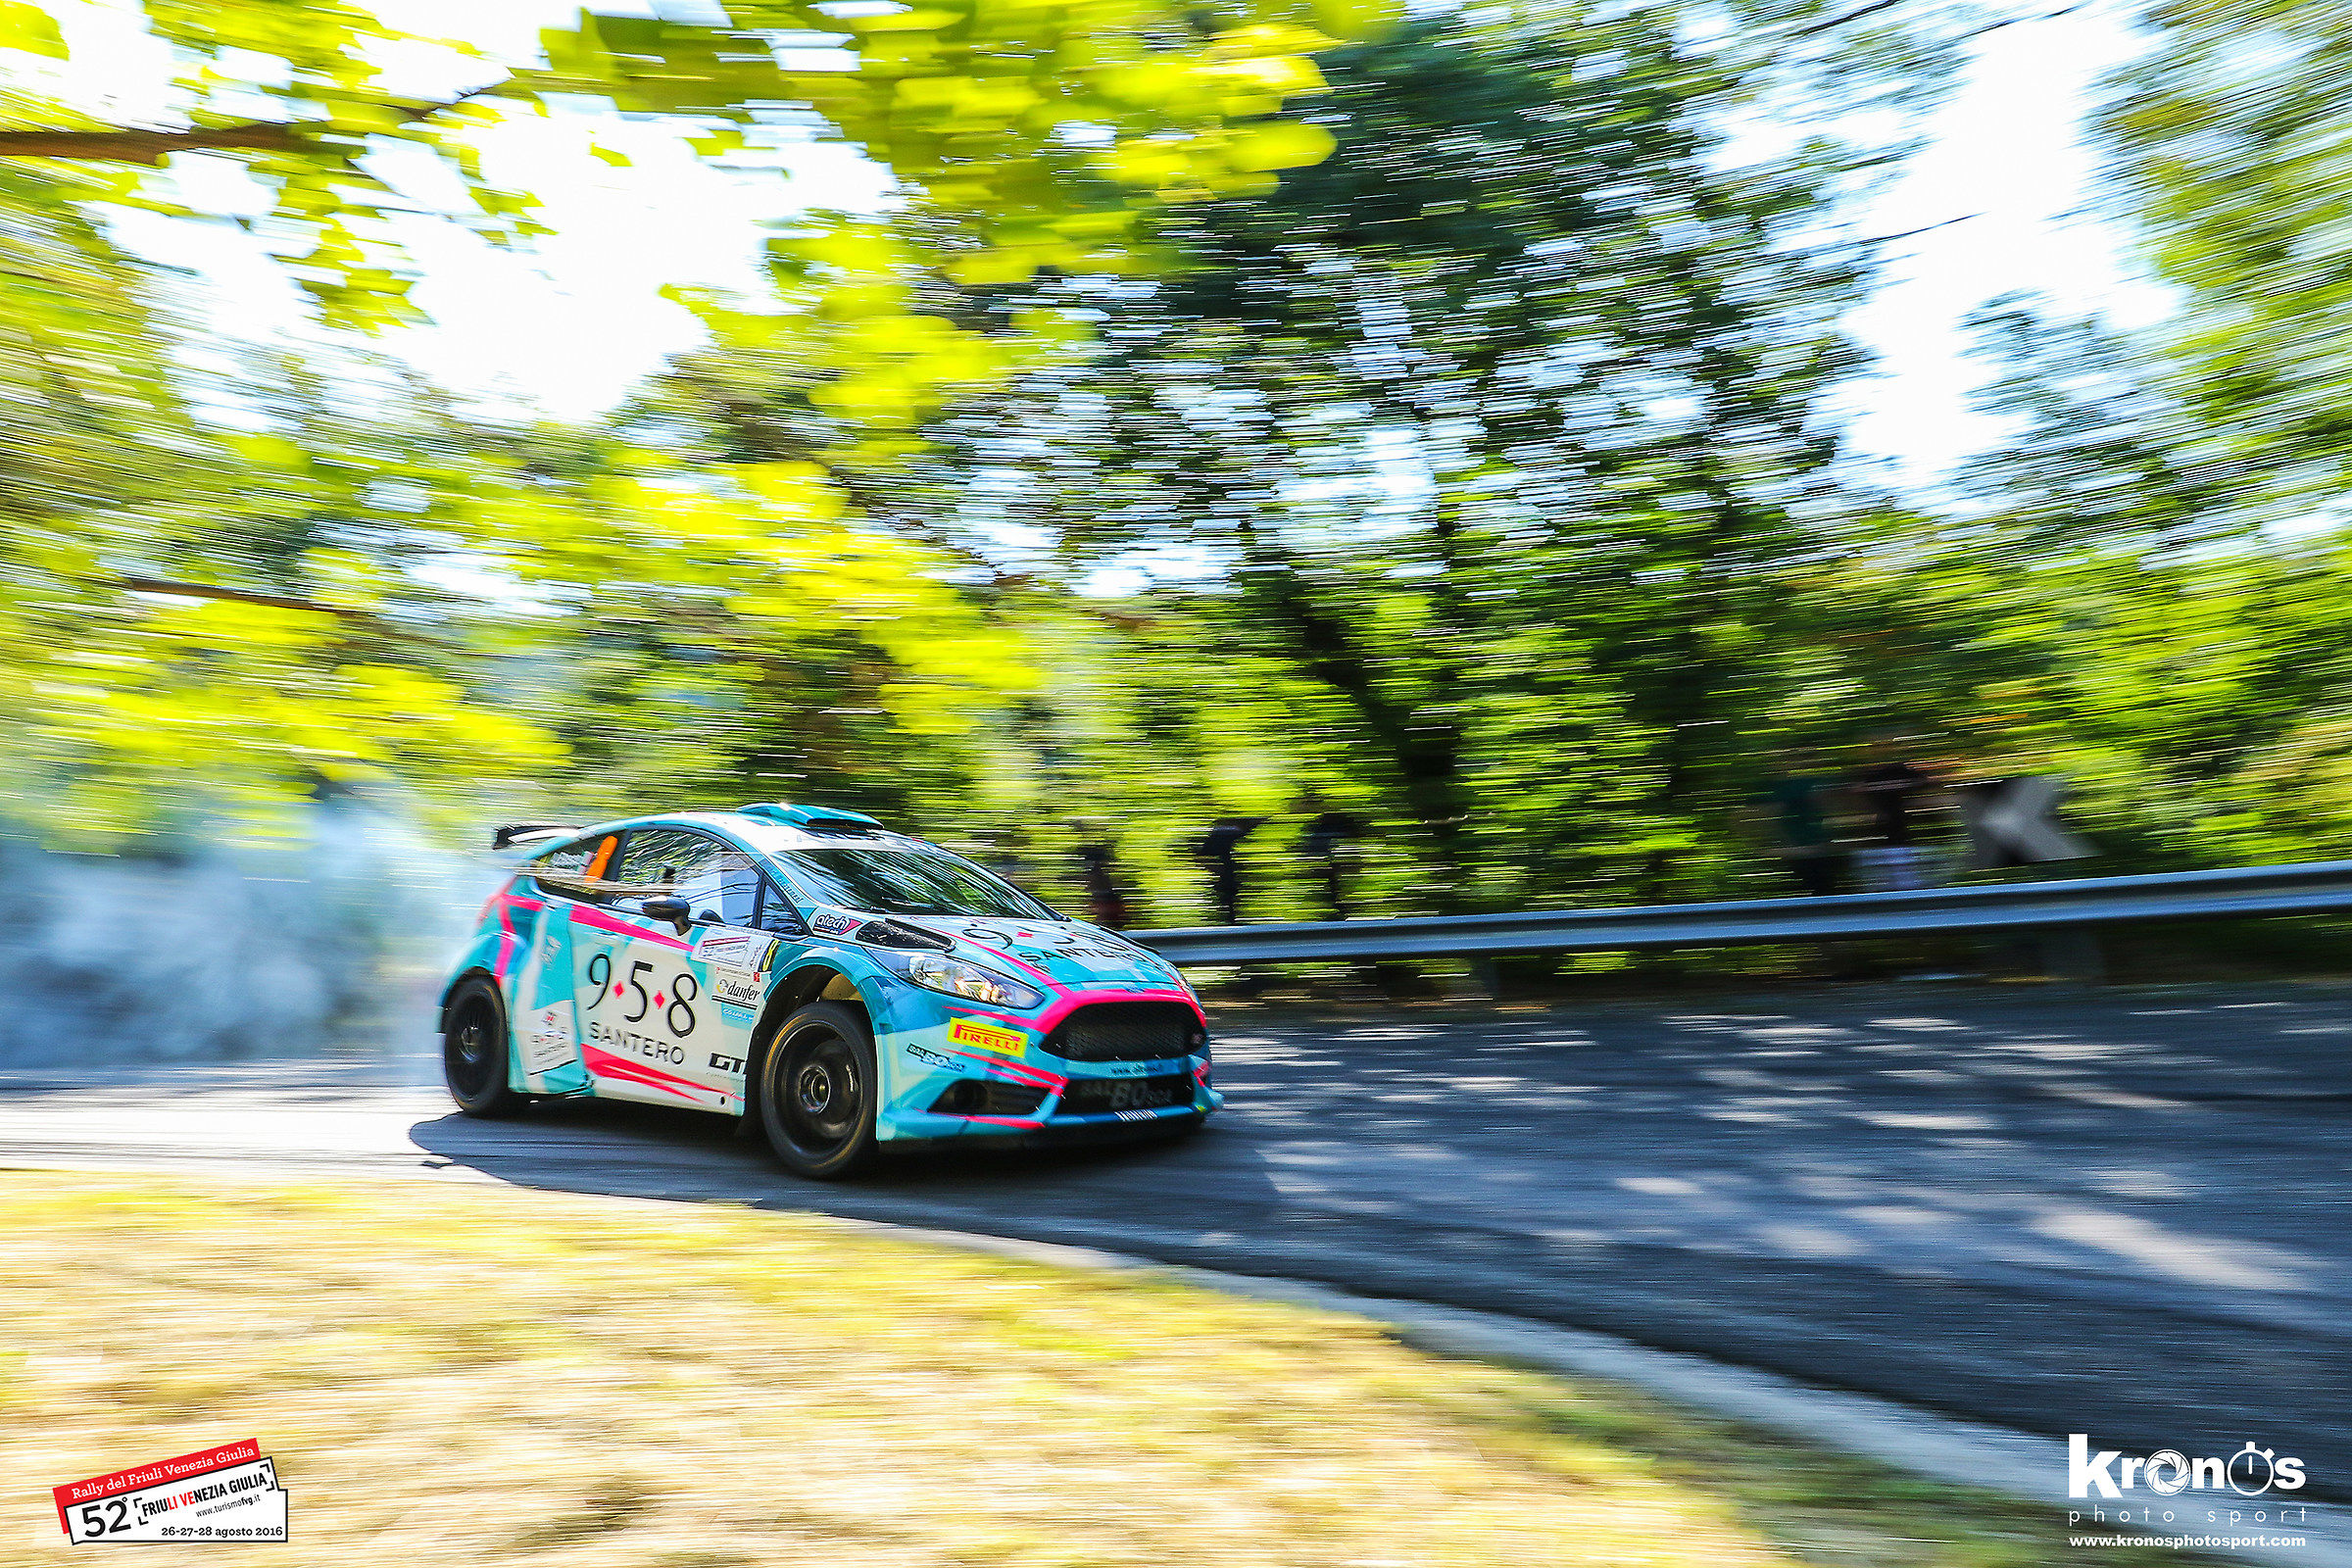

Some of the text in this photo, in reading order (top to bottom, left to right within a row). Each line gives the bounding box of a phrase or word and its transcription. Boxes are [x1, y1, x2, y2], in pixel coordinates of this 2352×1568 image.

[727, 980, 760, 1002] danfer
[590, 1021, 684, 1065] SANTERO
[955, 1023, 1021, 1052] PIRELLI
